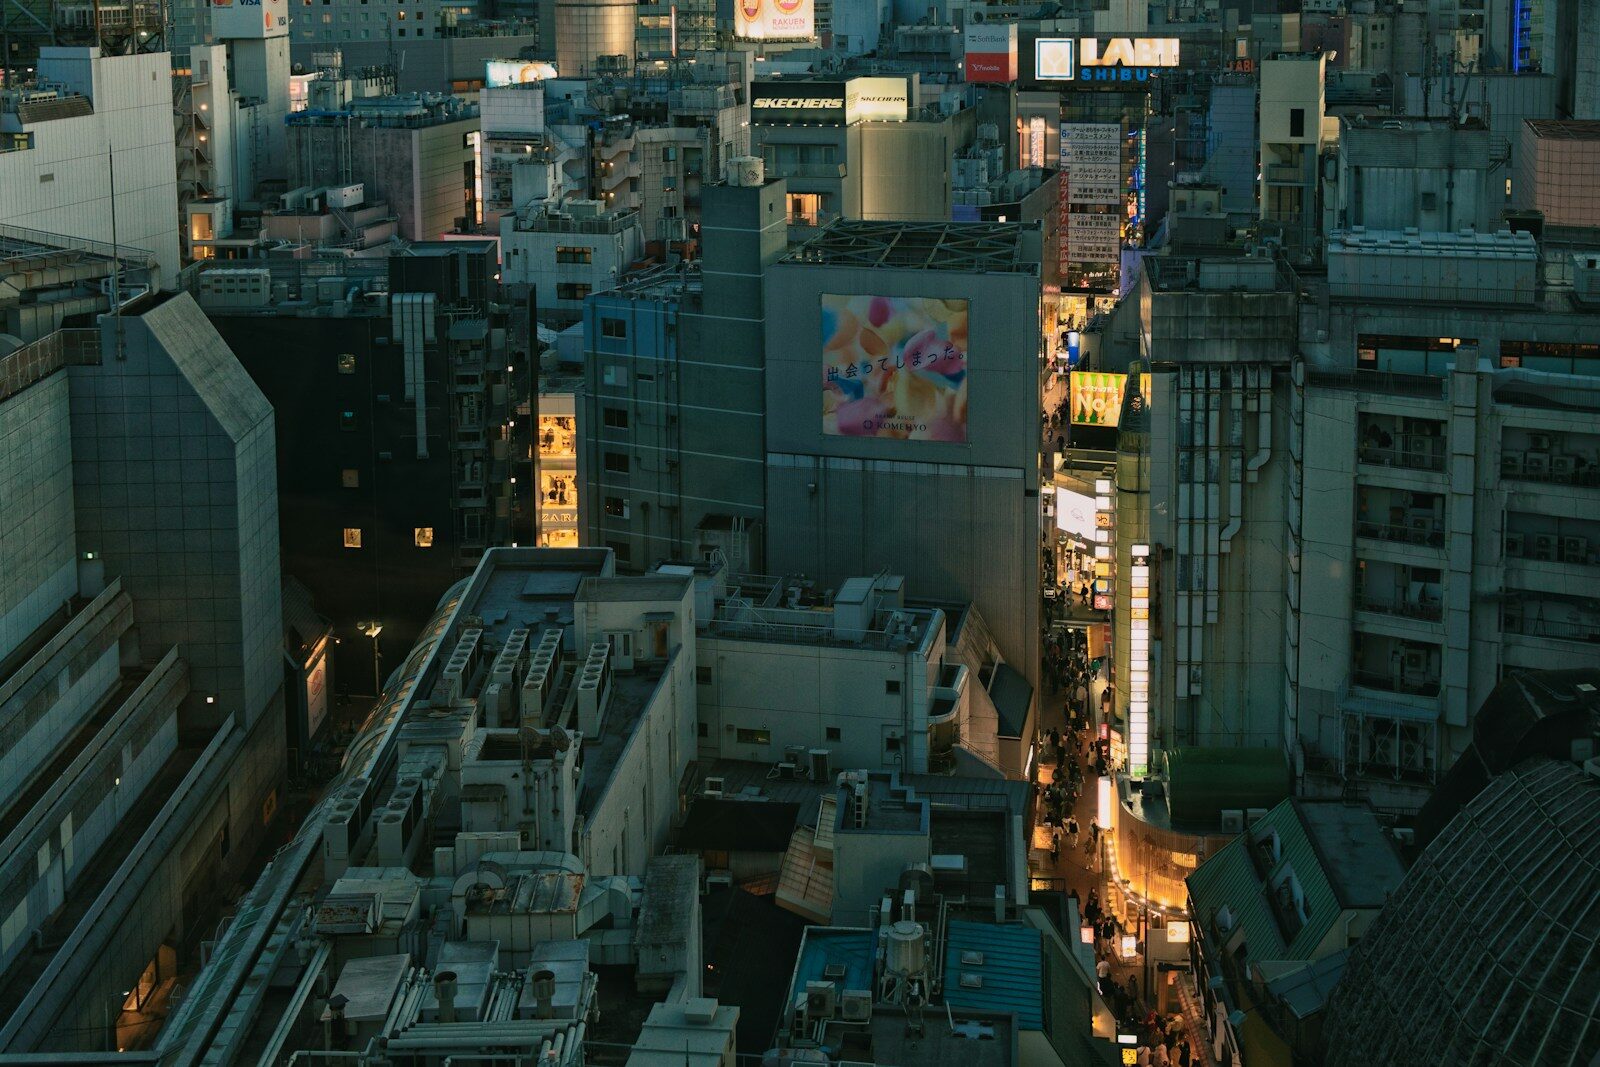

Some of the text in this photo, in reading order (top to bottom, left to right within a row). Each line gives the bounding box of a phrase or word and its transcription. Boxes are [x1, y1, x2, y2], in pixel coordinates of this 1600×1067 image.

[1080, 38, 1180, 66] LABI
[1081, 68, 1160, 81] SHIBU
[752, 98, 844, 109] SKECHERS
[827, 343, 965, 382] 出会ってしまった。
[877, 423, 927, 432] KOMEHYO
